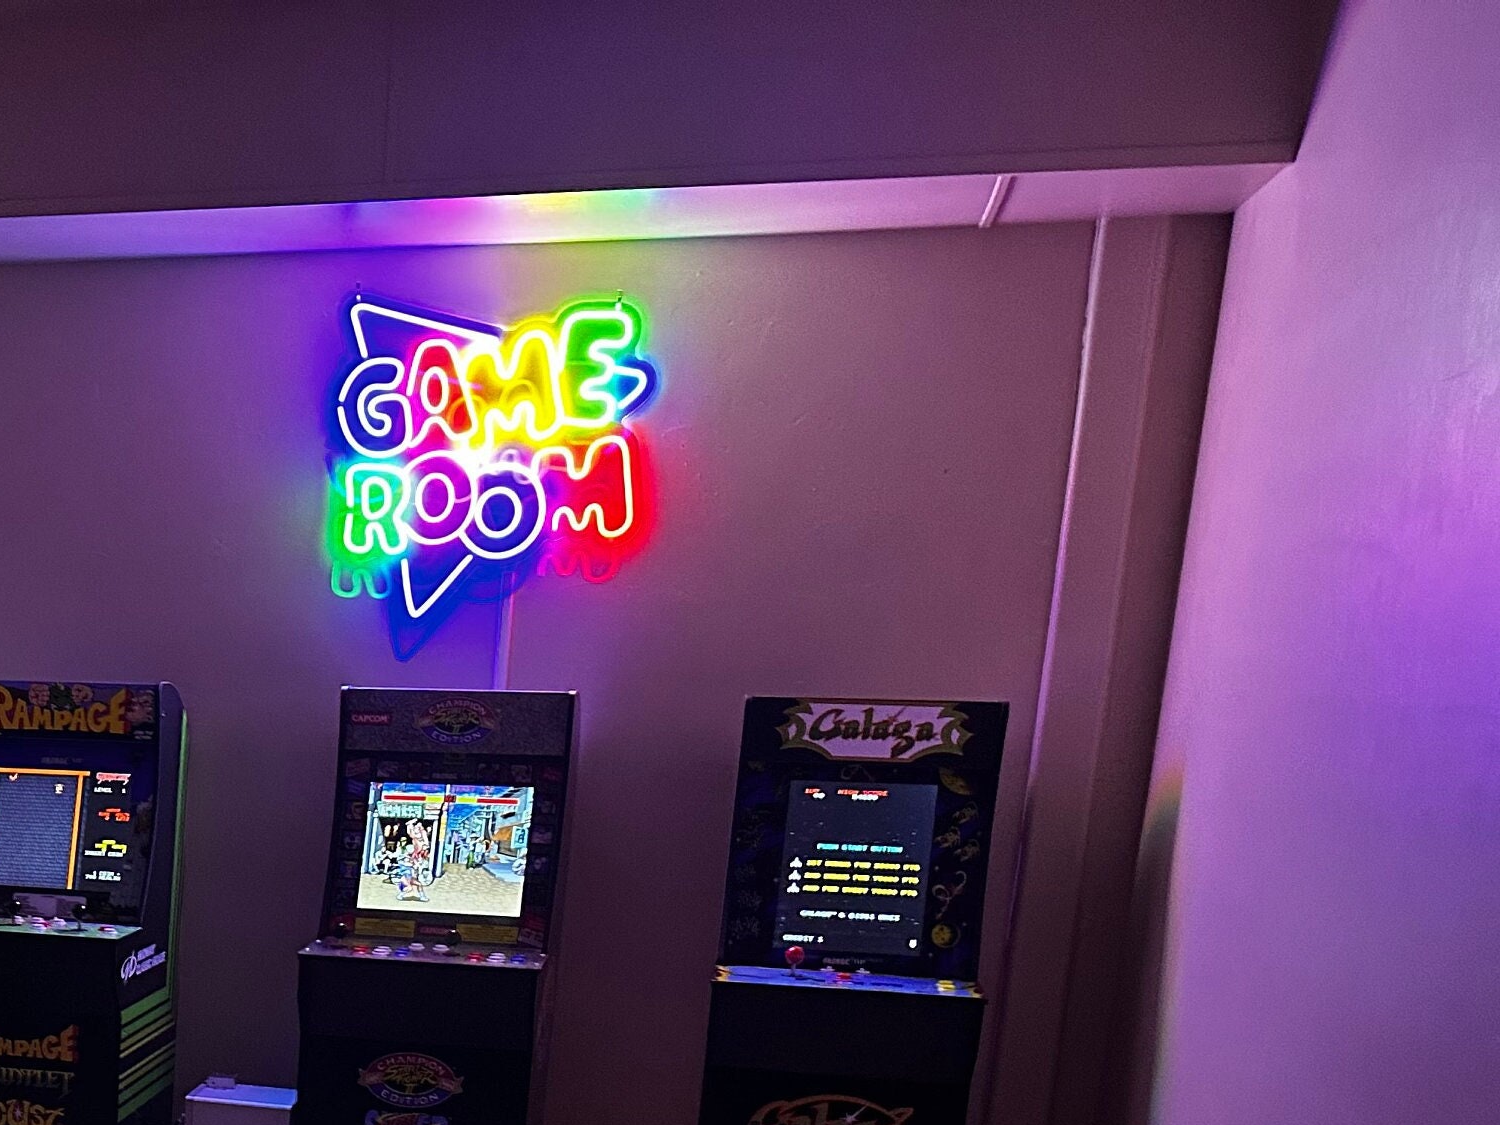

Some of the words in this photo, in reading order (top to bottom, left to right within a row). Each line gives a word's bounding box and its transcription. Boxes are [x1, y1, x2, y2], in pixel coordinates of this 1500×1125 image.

[337, 310, 634, 458] GAME
[343, 435, 634, 560] ROOM
[351, 714, 389, 723] CAPCOM
[431, 731, 482, 744] EDITION
[808, 706, 937, 758] Galaga
[377, 1056, 445, 1076] CHAMPION
[380, 1089, 439, 1105] EDITION
